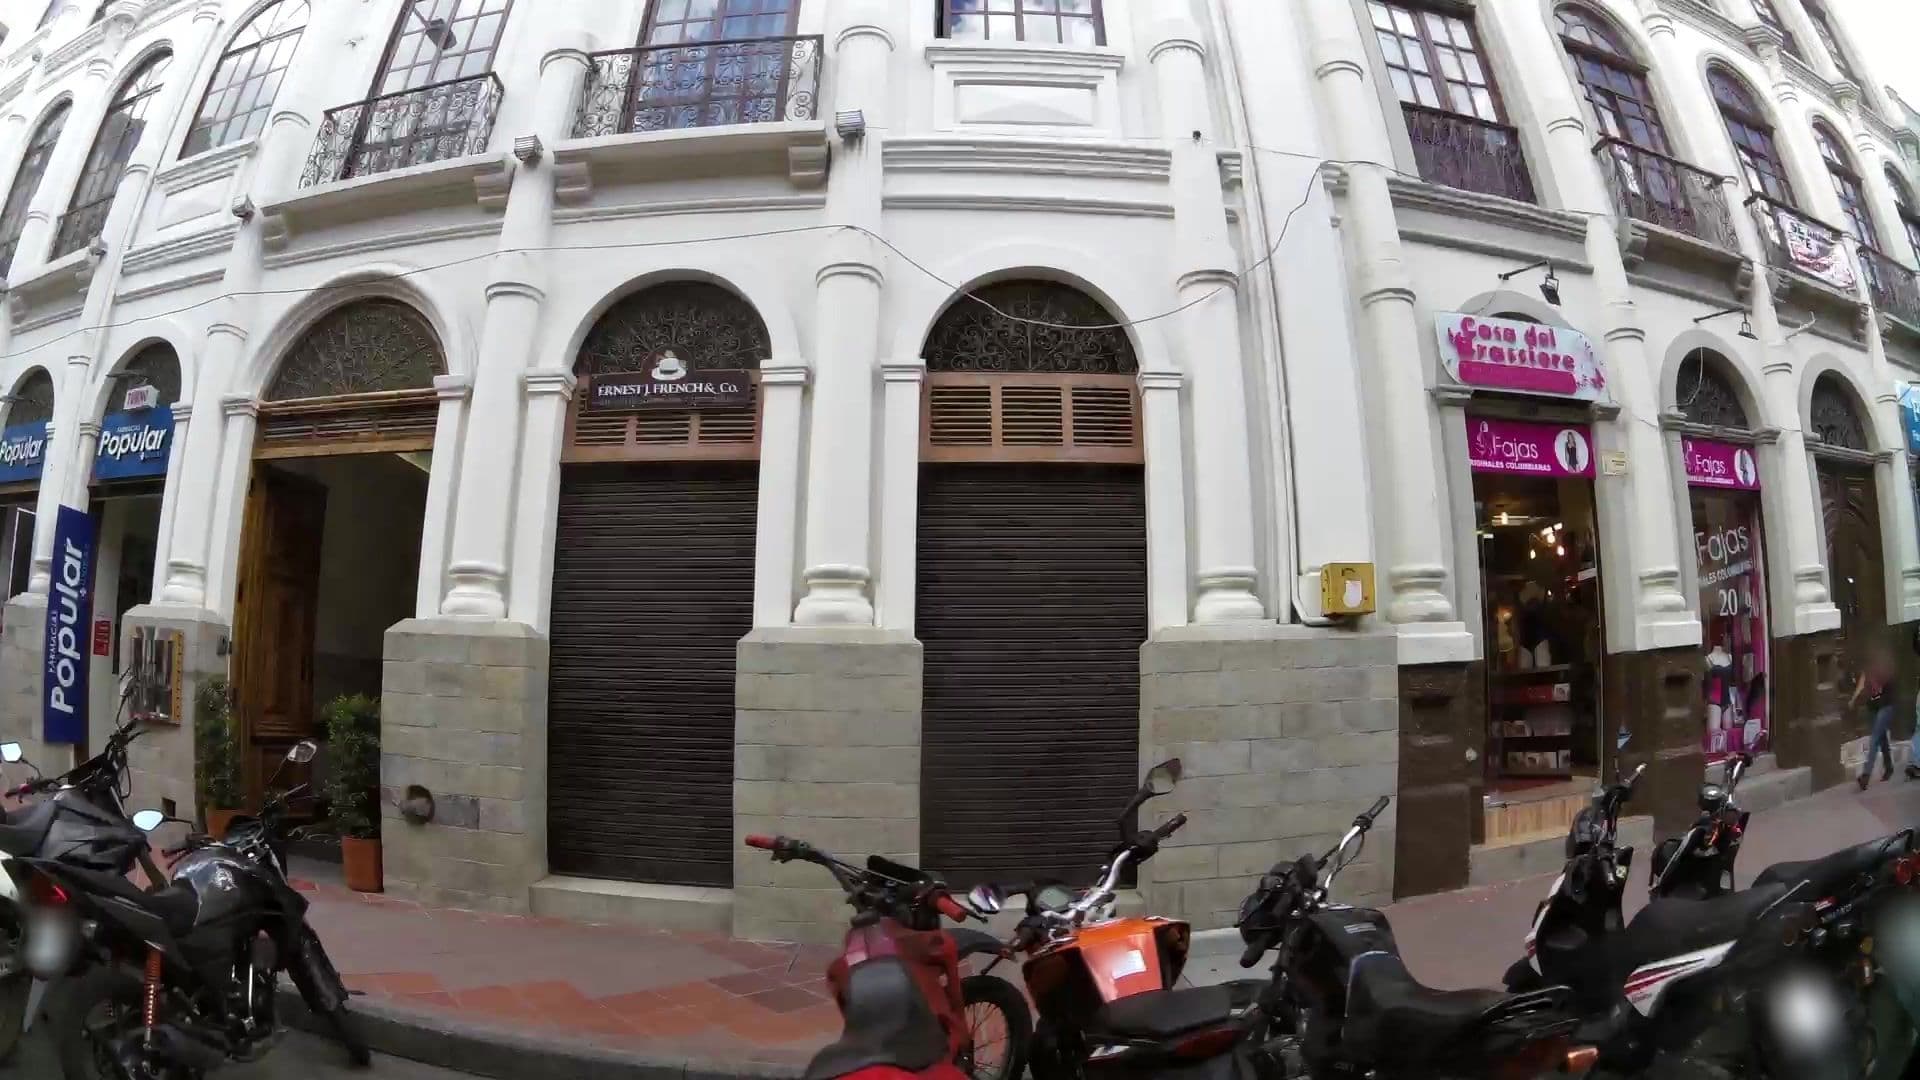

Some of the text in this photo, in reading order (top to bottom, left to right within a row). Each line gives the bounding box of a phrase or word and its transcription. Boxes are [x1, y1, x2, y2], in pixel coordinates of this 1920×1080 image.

[598, 384, 641, 397] ERNEST
[653, 382, 702, 395] FRENCH
[0, 435, 43, 467] Popular
[98, 425, 167, 460] Popular
[1492, 434, 1539, 462] Fajas
[1695, 454, 1725, 476] Fajas
[1694, 526, 1749, 566] Fajas
[1719, 588, 1738, 617] 20
[51, 537, 82, 714] Popular
